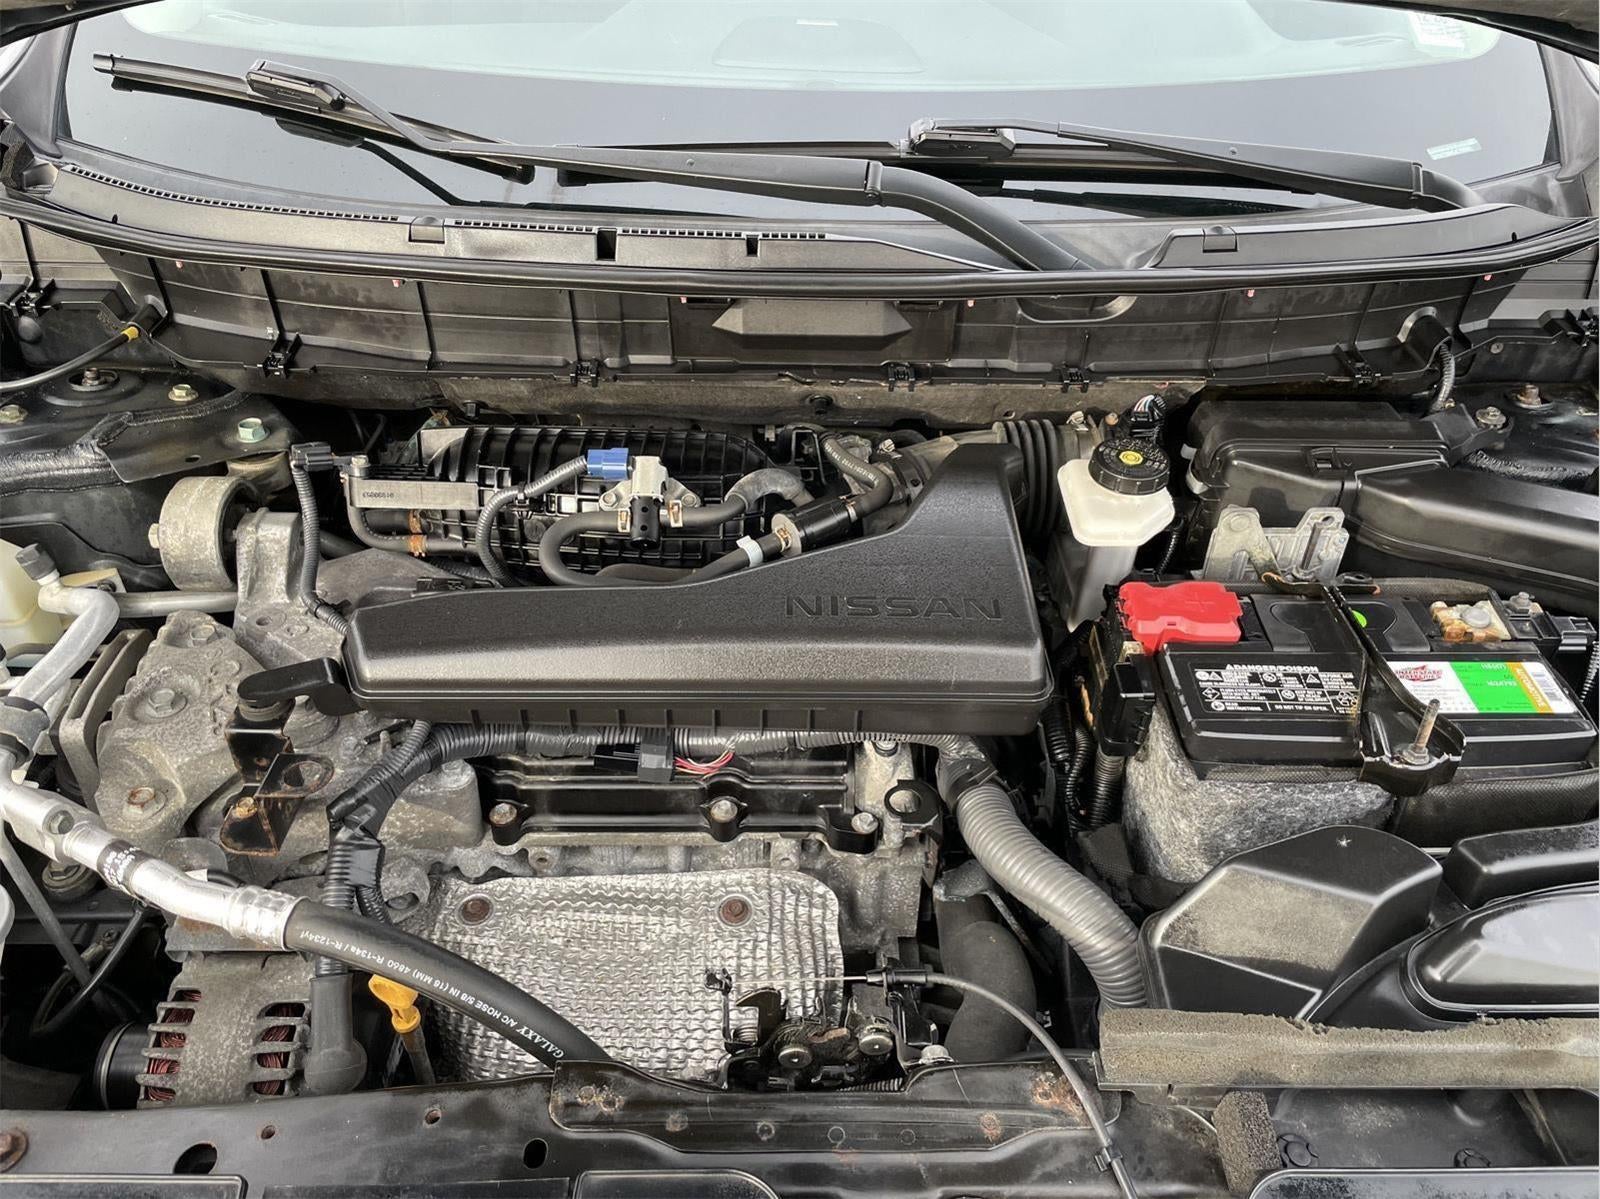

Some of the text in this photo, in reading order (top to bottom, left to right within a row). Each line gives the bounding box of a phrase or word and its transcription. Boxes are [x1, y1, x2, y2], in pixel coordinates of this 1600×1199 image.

[784, 595, 1003, 621] NISSAN
[299, 930, 343, 950] R-1234yf
[350, 945, 385, 964] R-134a
[412, 968, 433, 984] MM)
[434, 979, 449, 992] (16
[448, 986, 461, 998] IN
[460, 993, 475, 1005] 5/8
[474, 1000, 502, 1019] HOSE
[500, 1015, 518, 1027] A/C
[515, 1025, 564, 1059] GALAXY
